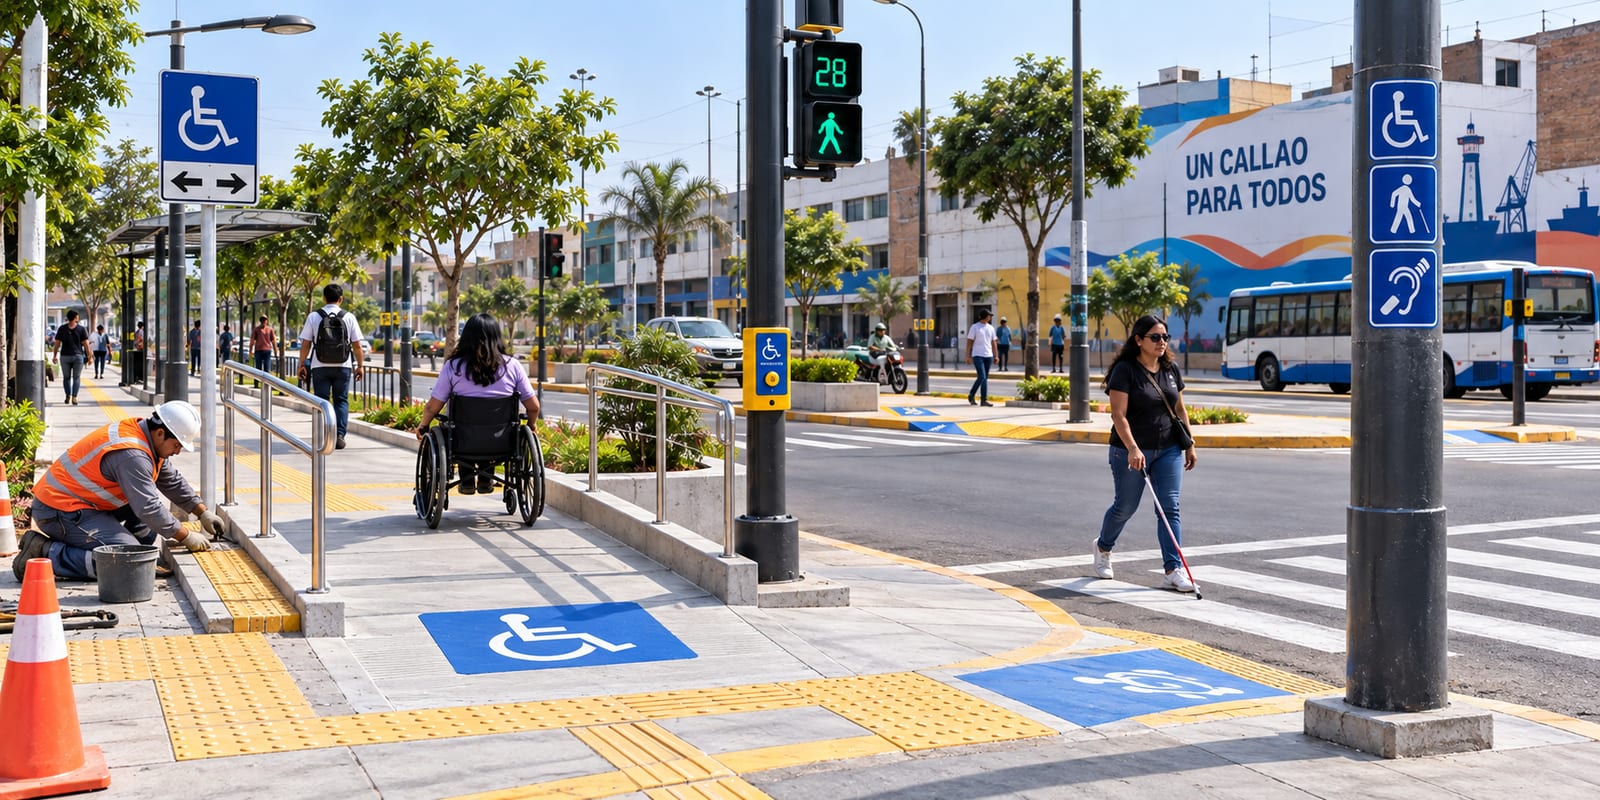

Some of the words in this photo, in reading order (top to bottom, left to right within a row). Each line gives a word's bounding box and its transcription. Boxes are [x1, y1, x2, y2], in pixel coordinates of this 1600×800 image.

[816, 56, 847, 88] 28
[1186, 151, 1213, 181] UN
[1220, 136, 1308, 176] CALLAO
[1187, 184, 1243, 216] PARA
[1248, 172, 1327, 209] TODOS
